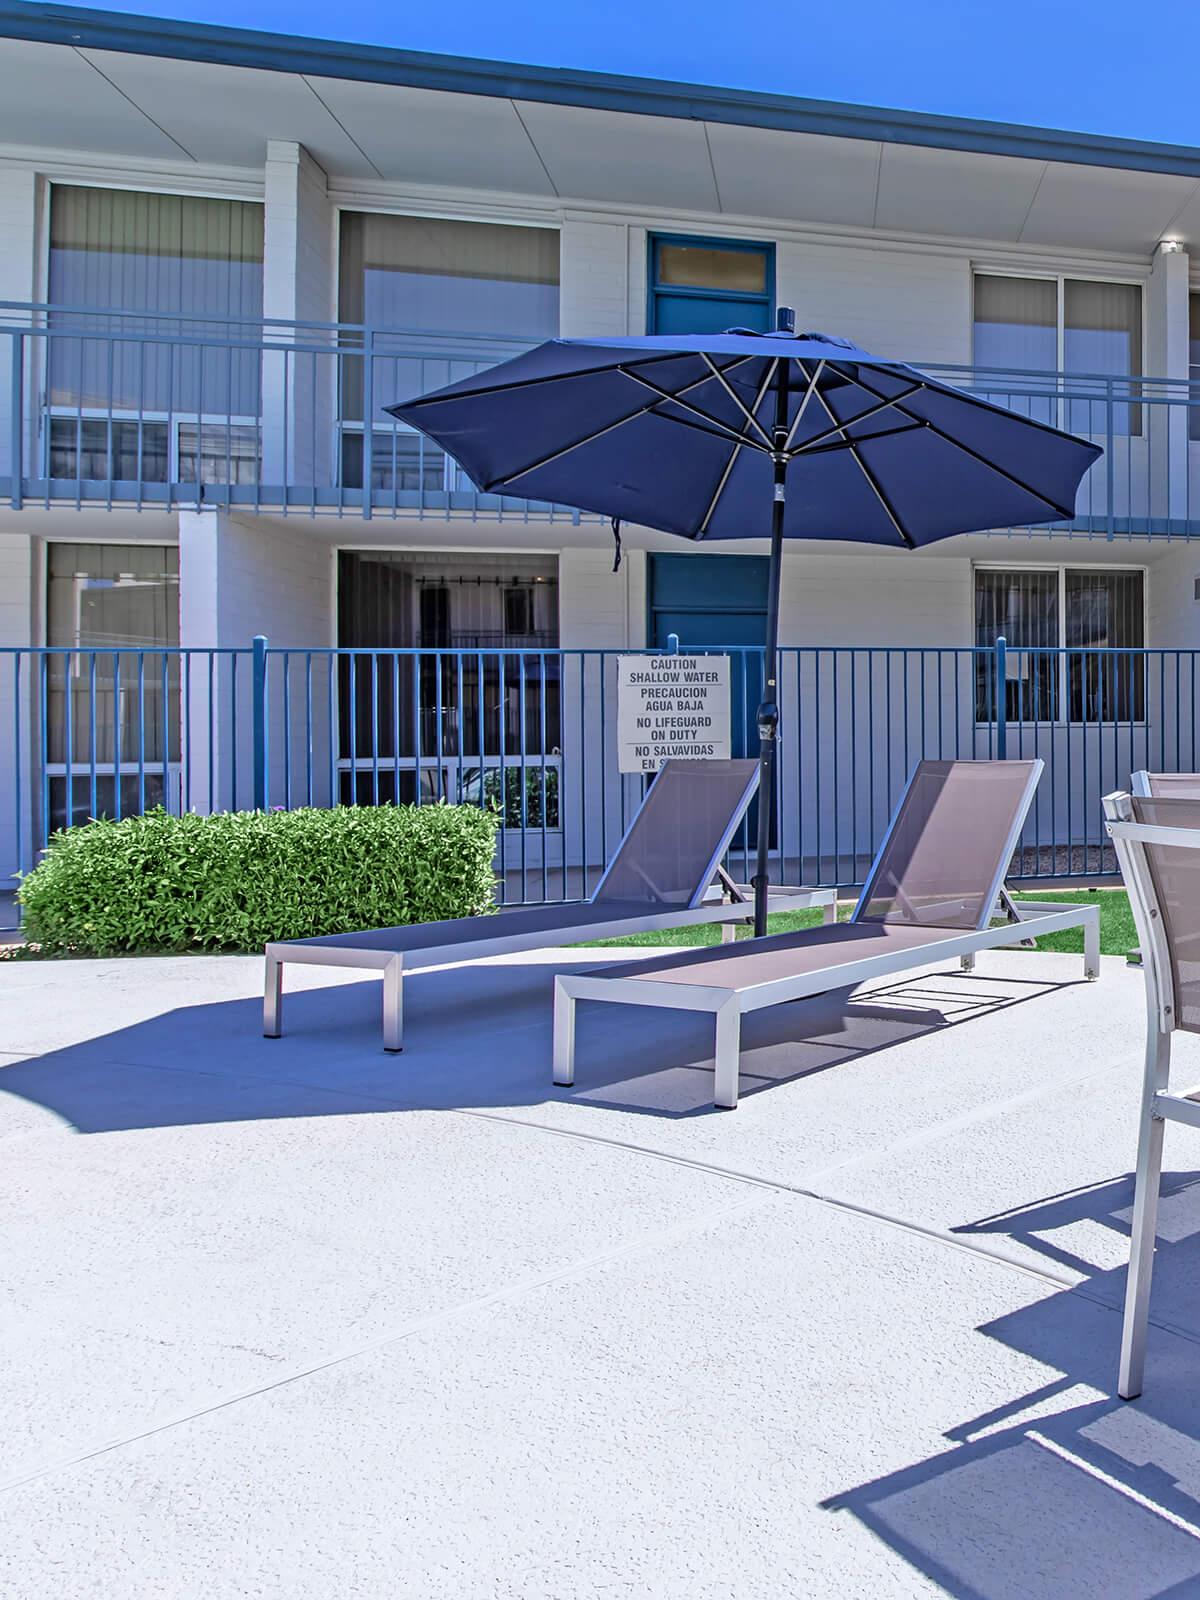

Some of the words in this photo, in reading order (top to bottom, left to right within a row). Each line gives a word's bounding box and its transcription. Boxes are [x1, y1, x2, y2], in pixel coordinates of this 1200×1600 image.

[651, 660, 696, 670] CAUTION
[630, 672, 680, 682] SHALLOW
[684, 672, 718, 682] WATER
[641, 688, 707, 698] PRECAUCION
[646, 701, 673, 711] AGUA
[678, 701, 704, 710] BAJA
[637, 718, 651, 728] NO
[656, 717, 712, 727] LIFEGUARD
[651, 730, 665, 740] ON
[670, 730, 698, 740] DUTY
[636, 746, 650, 756] NO
[654, 745, 714, 756] SALVAVIDAS
[642, 759, 655, 769] EN
